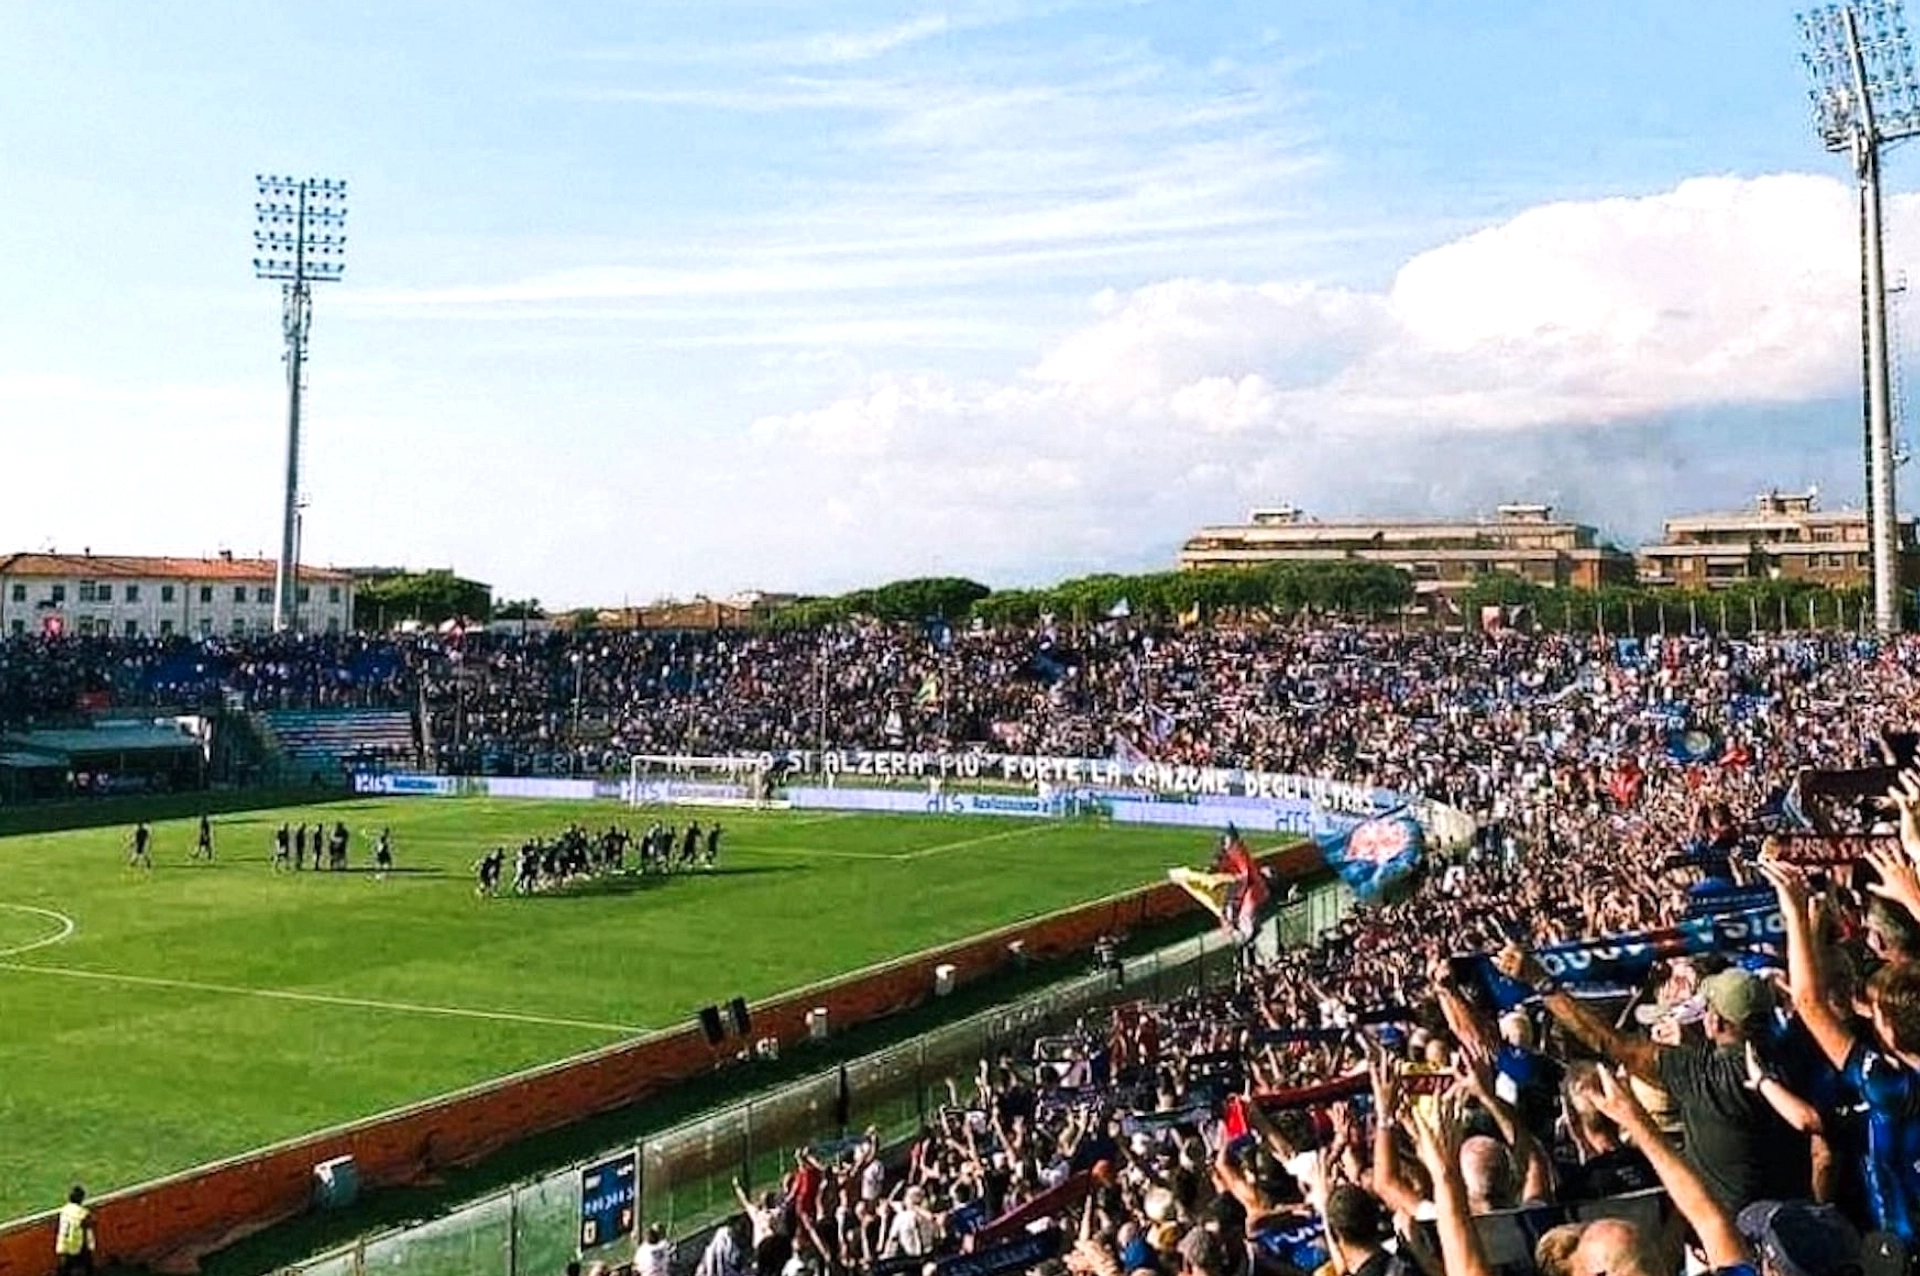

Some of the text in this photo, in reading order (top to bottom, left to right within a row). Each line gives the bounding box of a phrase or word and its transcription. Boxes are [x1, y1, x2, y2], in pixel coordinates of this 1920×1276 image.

[1003, 754, 1081, 782] FORTE
[1092, 758, 1121, 785] LA
[1132, 762, 1230, 795] CANZONE
[1244, 773, 1301, 798] DEGLI
